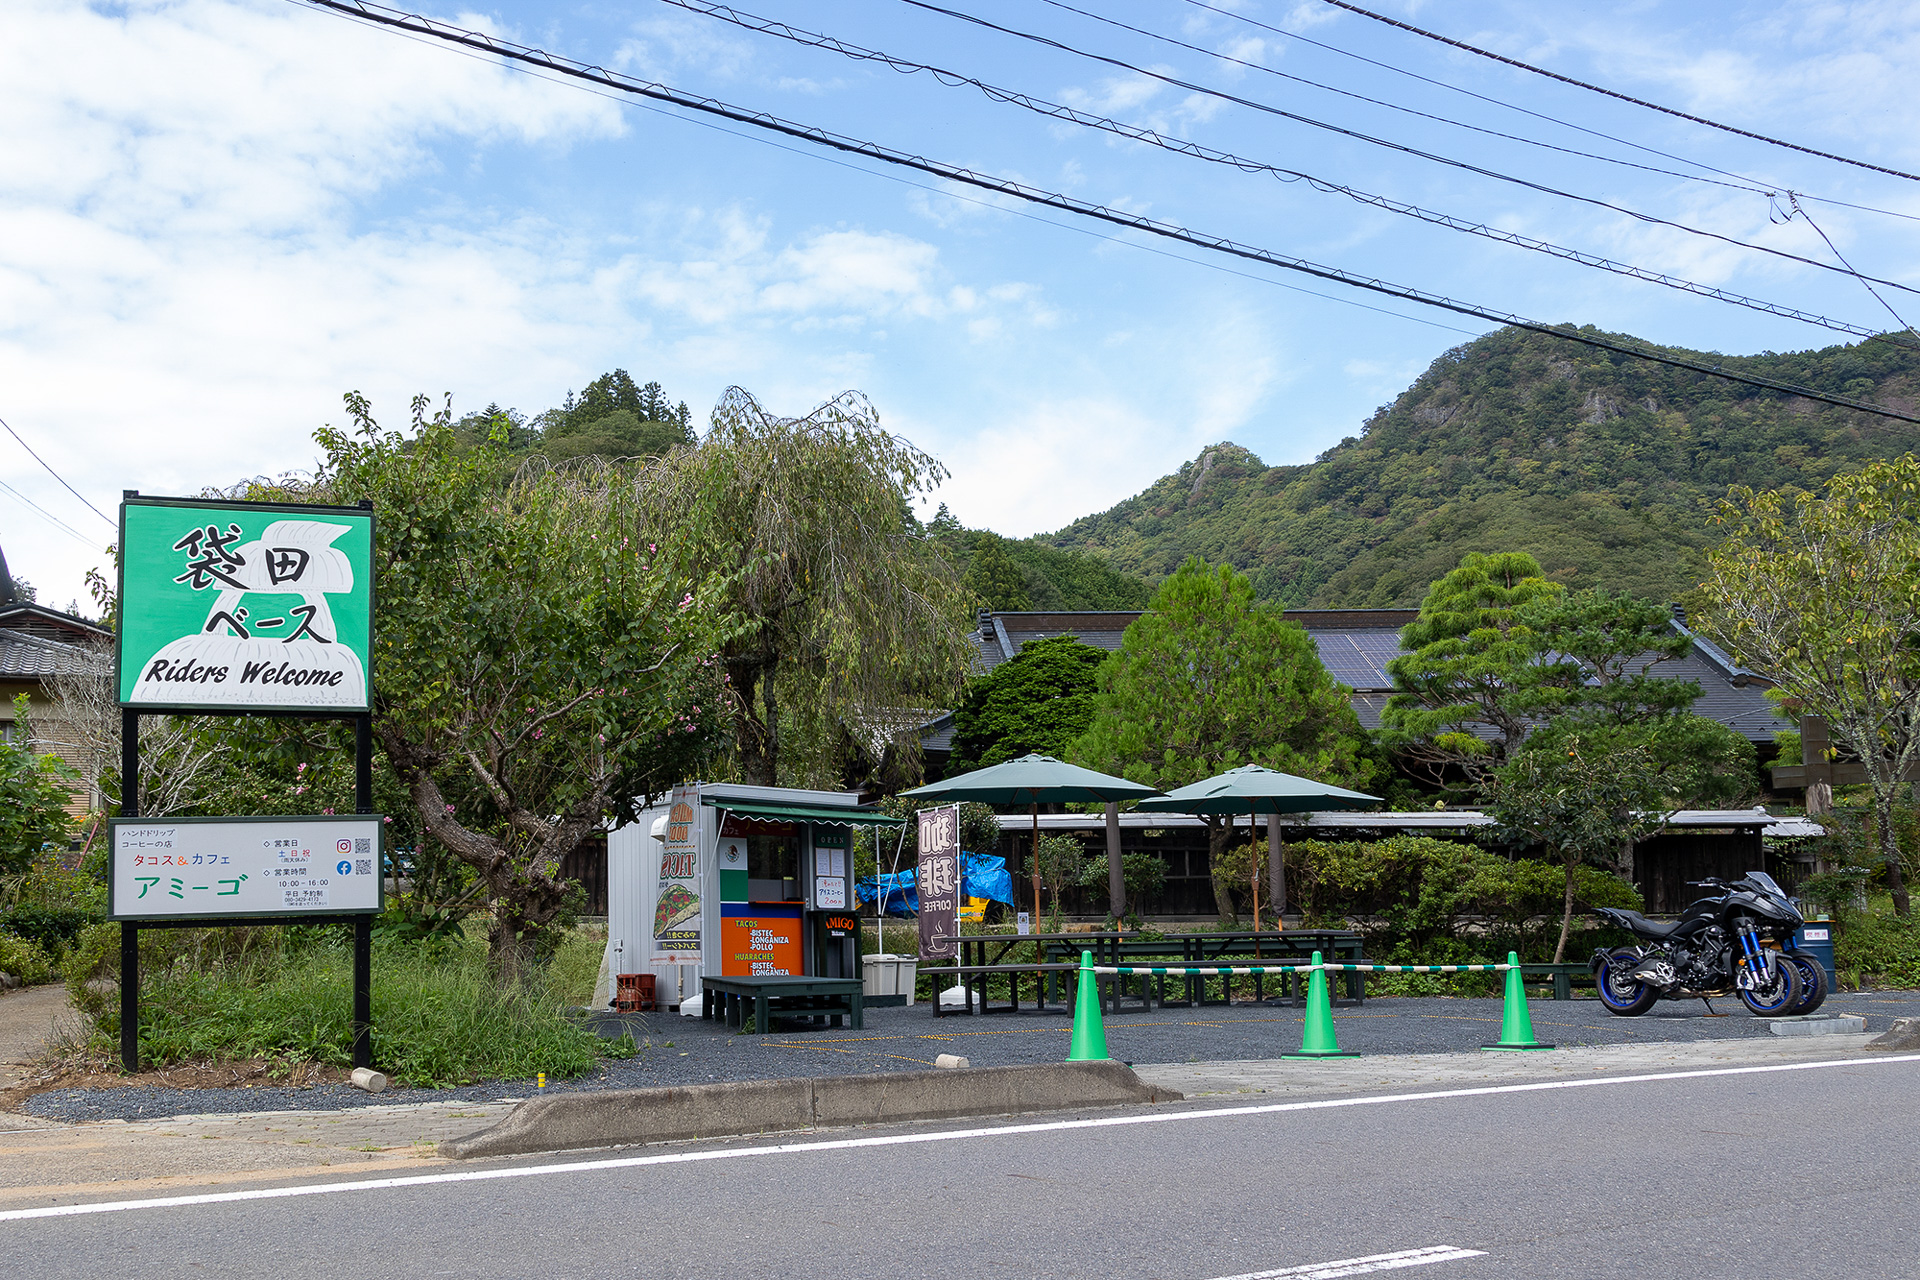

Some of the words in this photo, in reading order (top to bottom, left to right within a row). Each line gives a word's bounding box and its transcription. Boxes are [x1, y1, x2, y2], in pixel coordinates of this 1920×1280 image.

[174, 523, 310, 590] 袋田
[205, 605, 332, 644] ベース
[145, 658, 229, 684] Riders
[240, 661, 343, 687] Welcome
[122, 829, 175, 837] ハンドドリップ
[122, 840, 172, 848] コーヒーの店
[274, 839, 298, 848] 営業日
[278, 850, 286, 858] 土
[302, 849, 310, 857] 祝
[274, 868, 307, 877] 営業時間
[134, 873, 249, 899] アミーゴ
[735, 920, 758, 928] TACOS
[734, 953, 774, 961] HUARACHES
[752, 969, 790, 977] LONGANIZA
